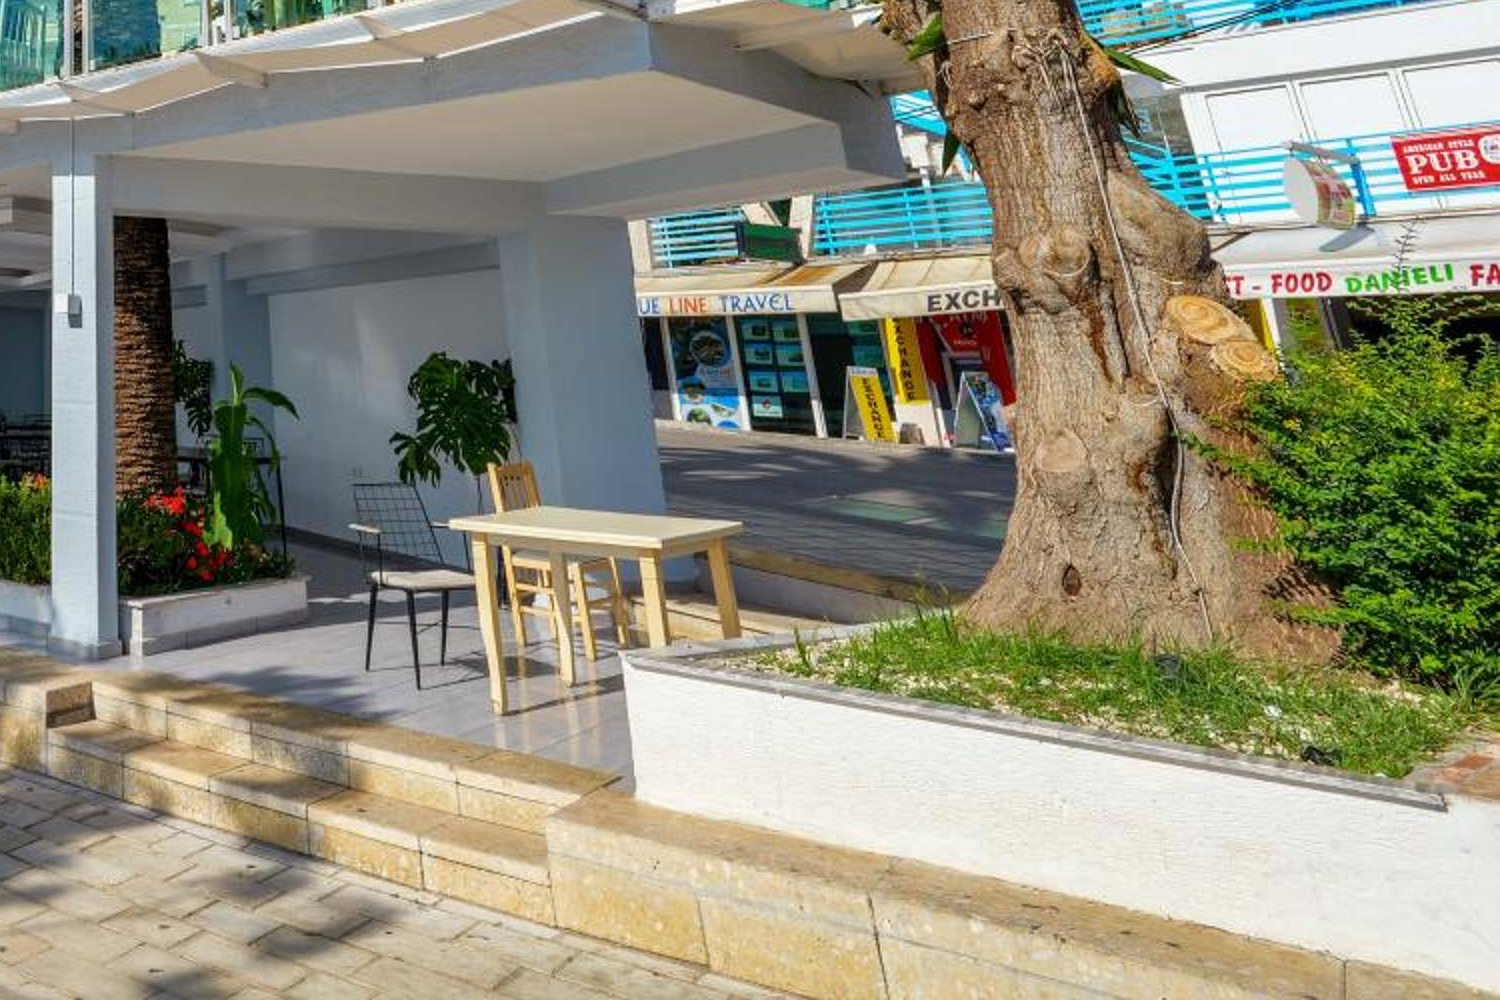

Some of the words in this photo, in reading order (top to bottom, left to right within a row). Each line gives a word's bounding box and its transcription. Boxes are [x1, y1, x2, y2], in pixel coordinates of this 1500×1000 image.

[1404, 149, 1479, 175] PUB
[1271, 271, 1333, 294] FOOD
[668, 295, 708, 313] LINE
[718, 292, 797, 312] TRAVEL
[927, 289, 1002, 313] EXCH
